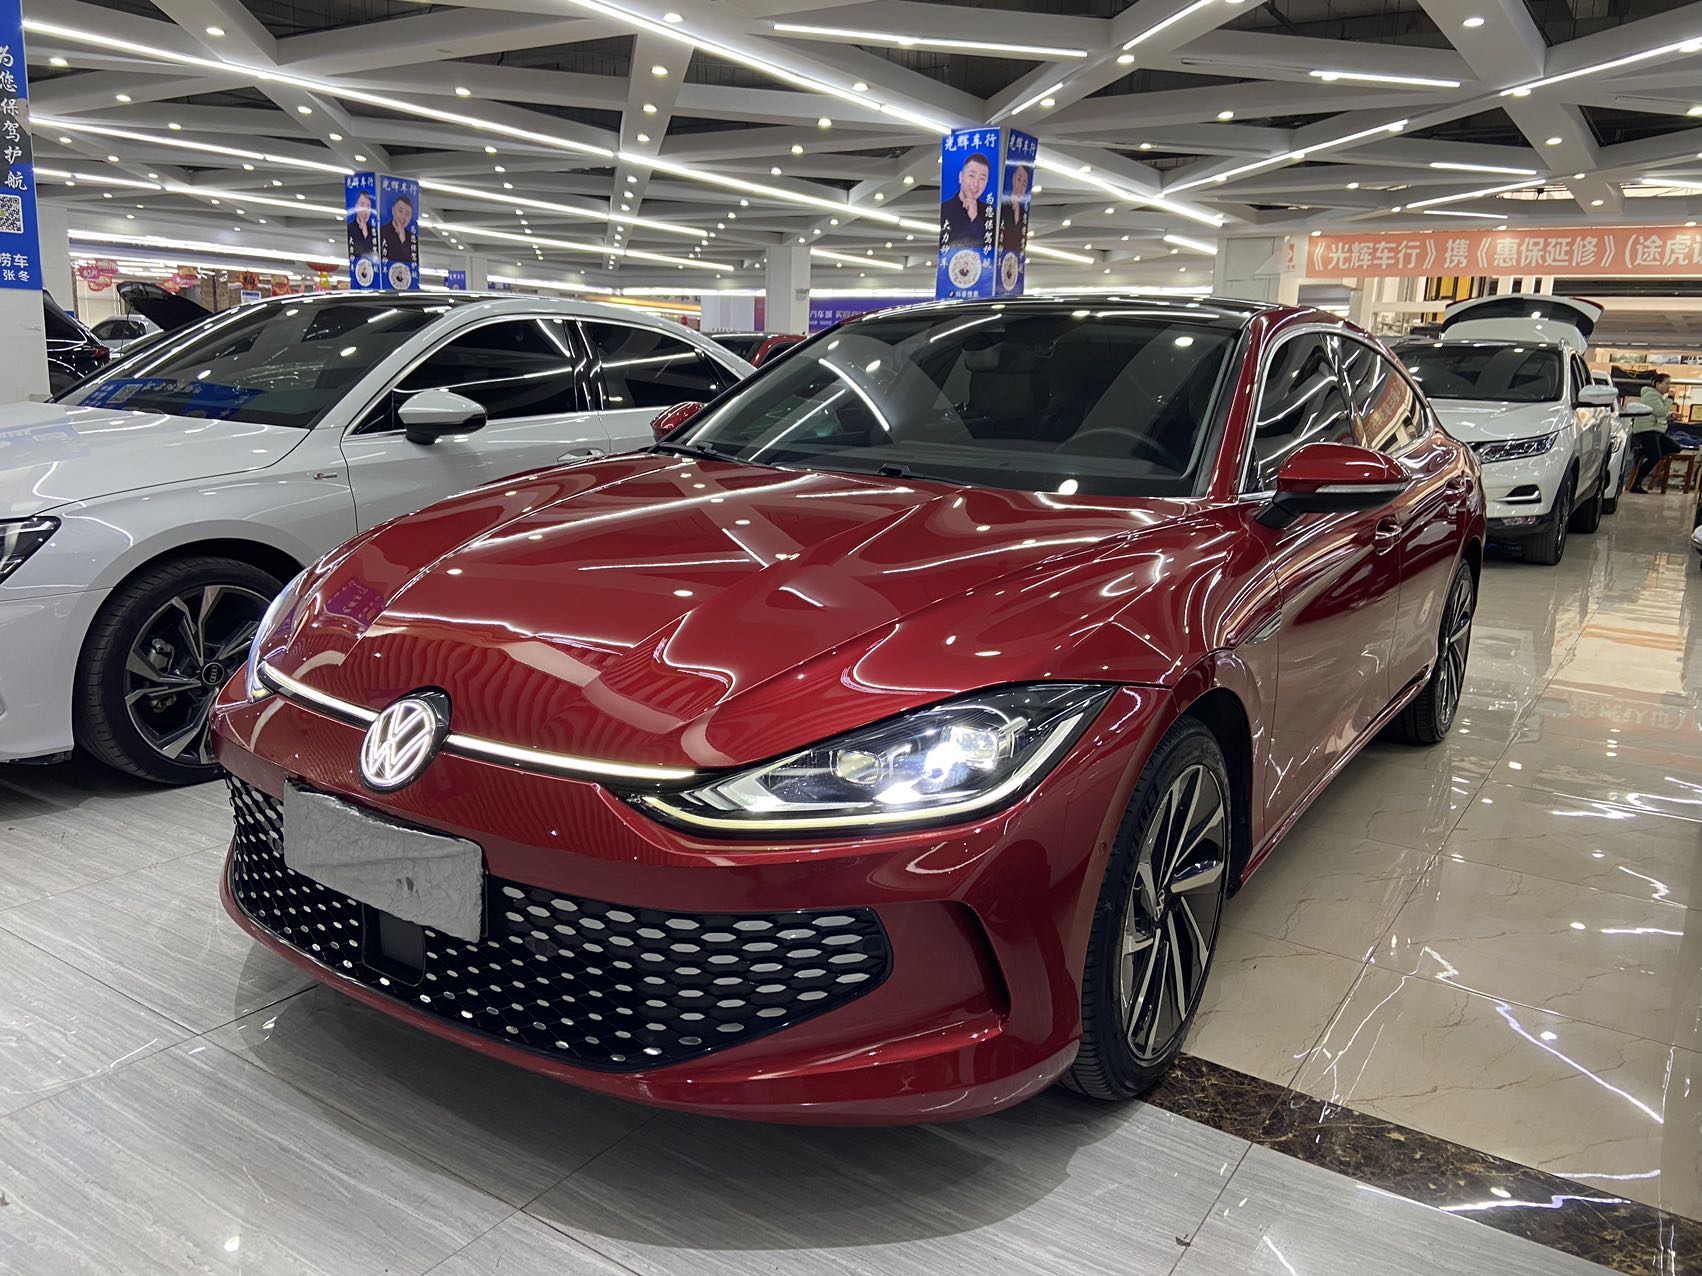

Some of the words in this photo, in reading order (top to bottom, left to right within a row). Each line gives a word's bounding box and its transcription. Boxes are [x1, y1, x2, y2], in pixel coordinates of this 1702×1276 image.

[0, 45, 27, 191] 为您保驾护航
